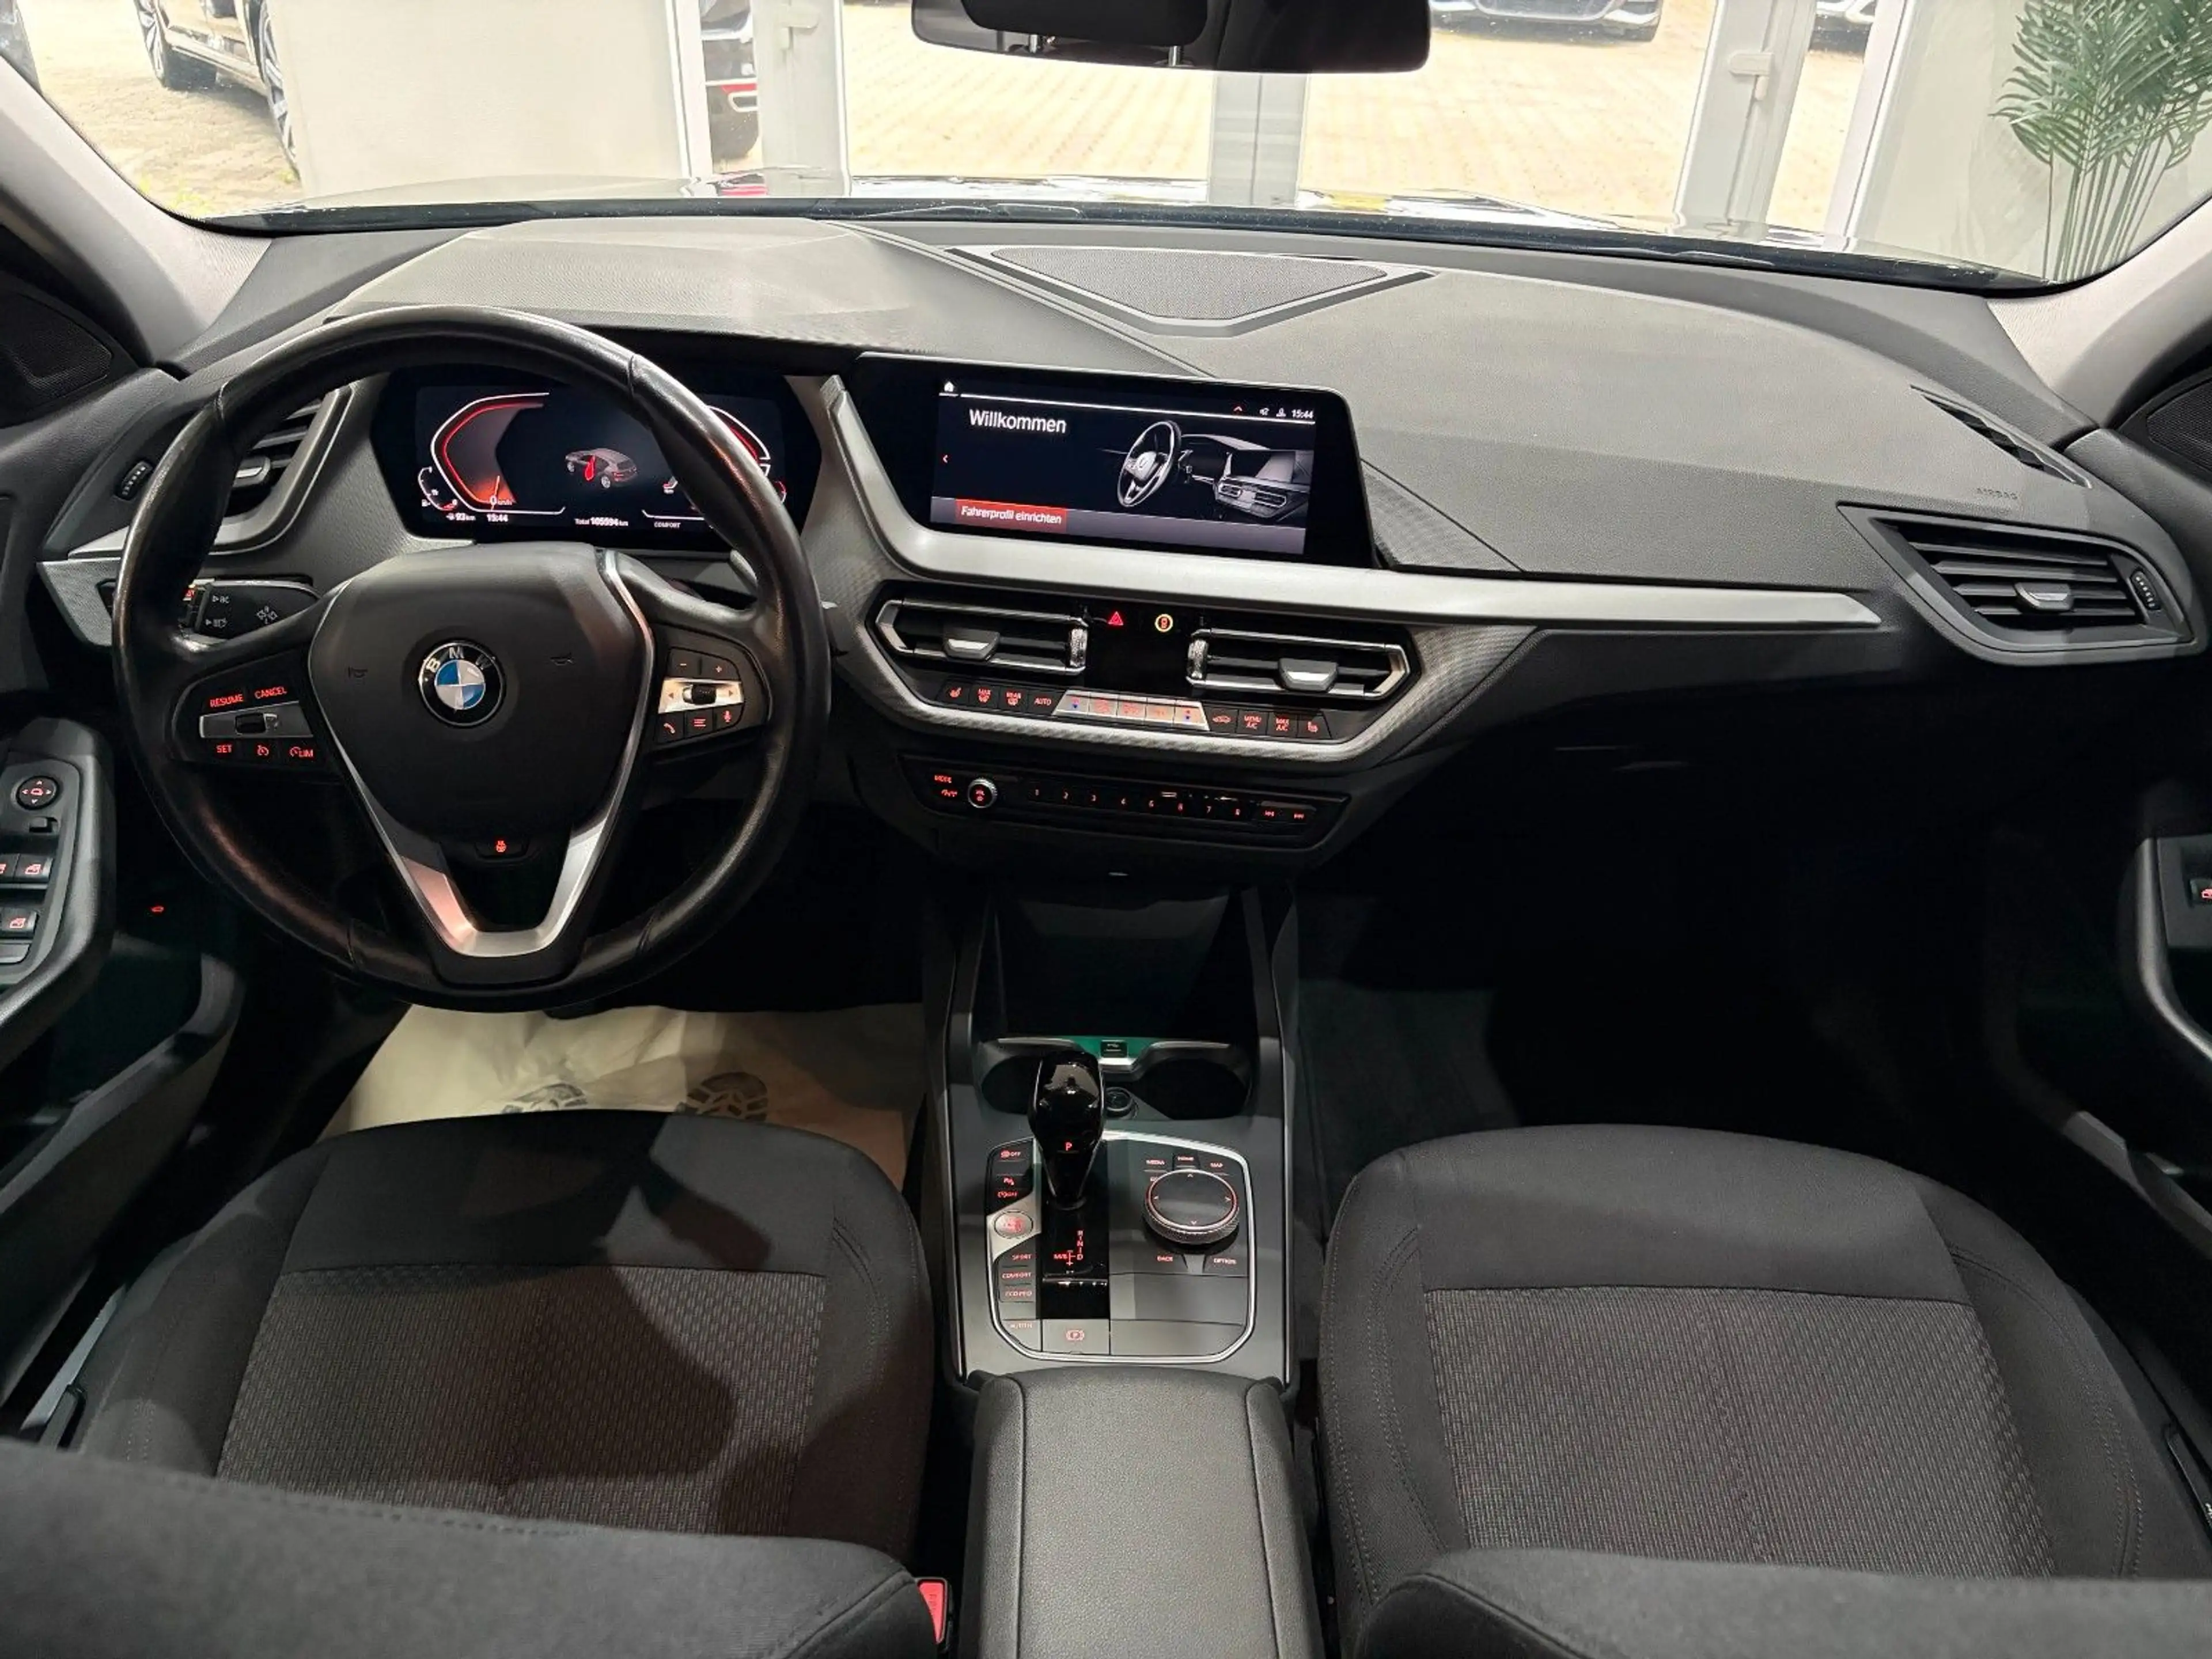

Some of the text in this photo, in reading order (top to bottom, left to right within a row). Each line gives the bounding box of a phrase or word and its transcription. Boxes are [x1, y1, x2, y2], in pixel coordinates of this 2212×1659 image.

[969, 409, 1066, 433] Willkommen
[456, 513, 466, 521] 93
[961, 505, 1063, 525] Fahrerprofil einrichten
[426, 645, 493, 673] BMW
[254, 685, 288, 700] CANCEL
[209, 693, 245, 708] RESUME
[1034, 697, 1052, 706] AUTO
[216, 744, 233, 753] SET
[1066, 1142, 1073, 1151] P
